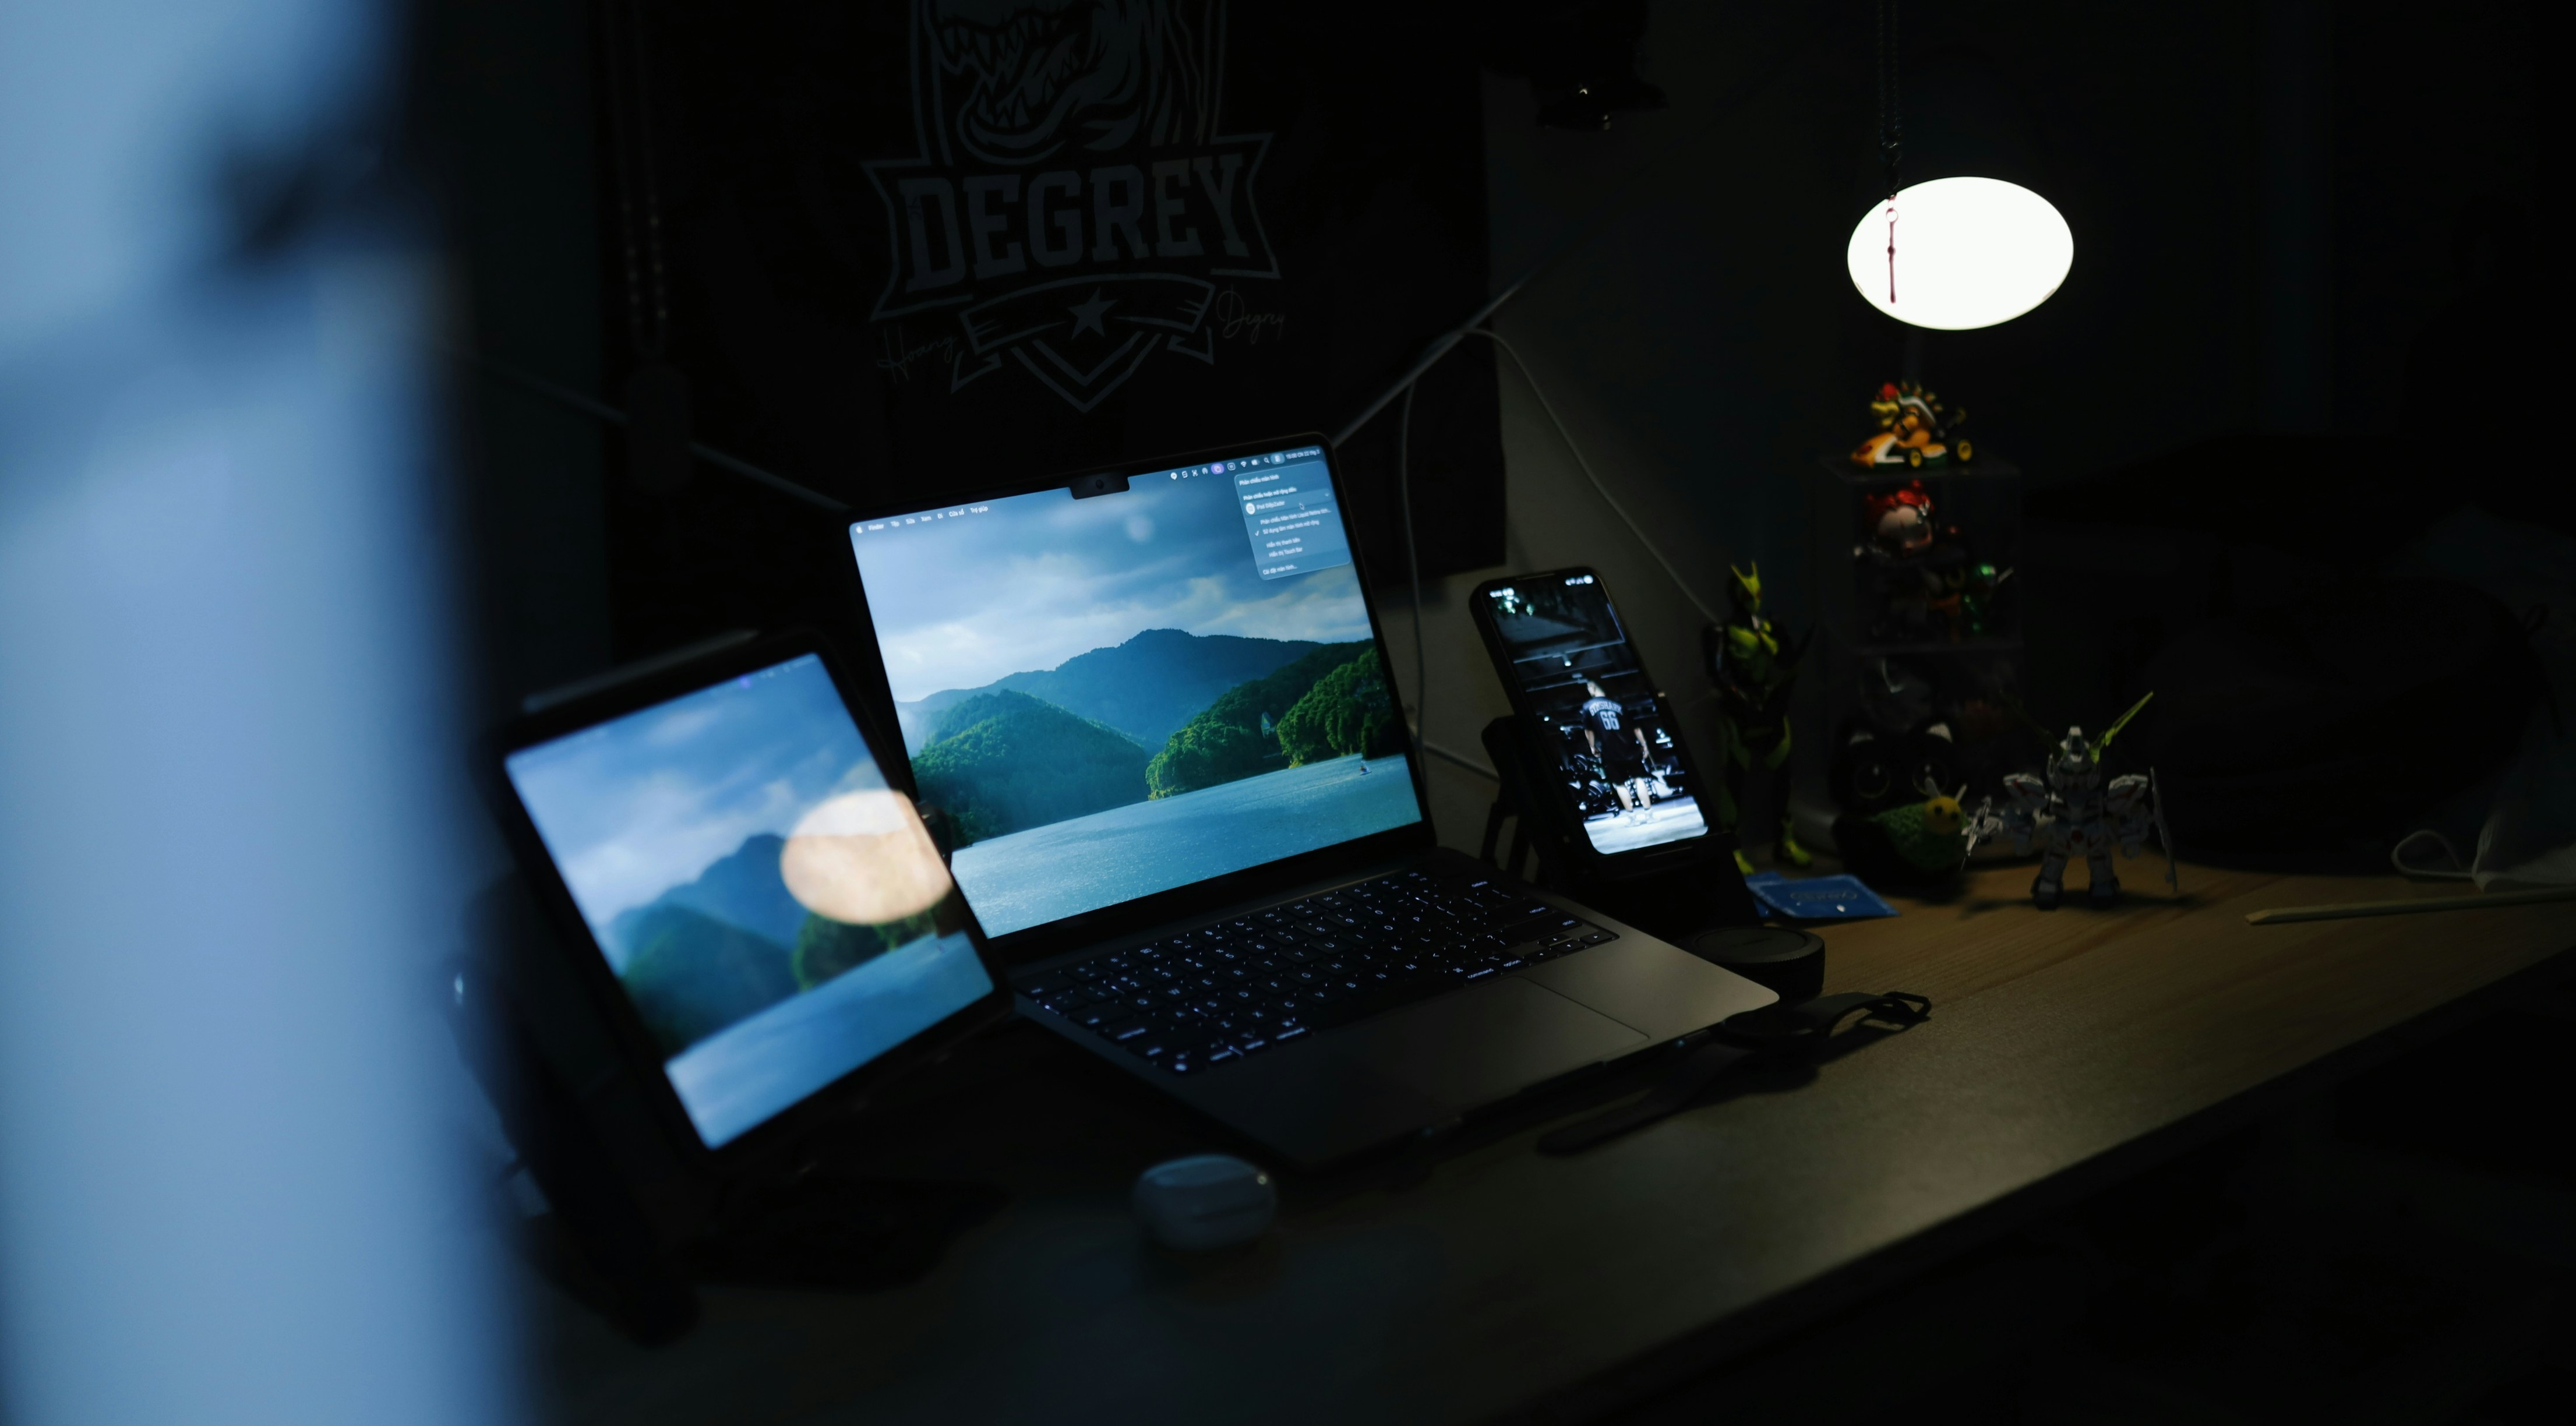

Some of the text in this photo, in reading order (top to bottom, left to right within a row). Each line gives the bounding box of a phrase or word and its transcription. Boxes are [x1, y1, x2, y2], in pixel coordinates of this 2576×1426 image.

[897, 153, 1250, 292] DEGREY
[1216, 284, 1285, 344] Degrey
[1600, 711, 1619, 730] 66
